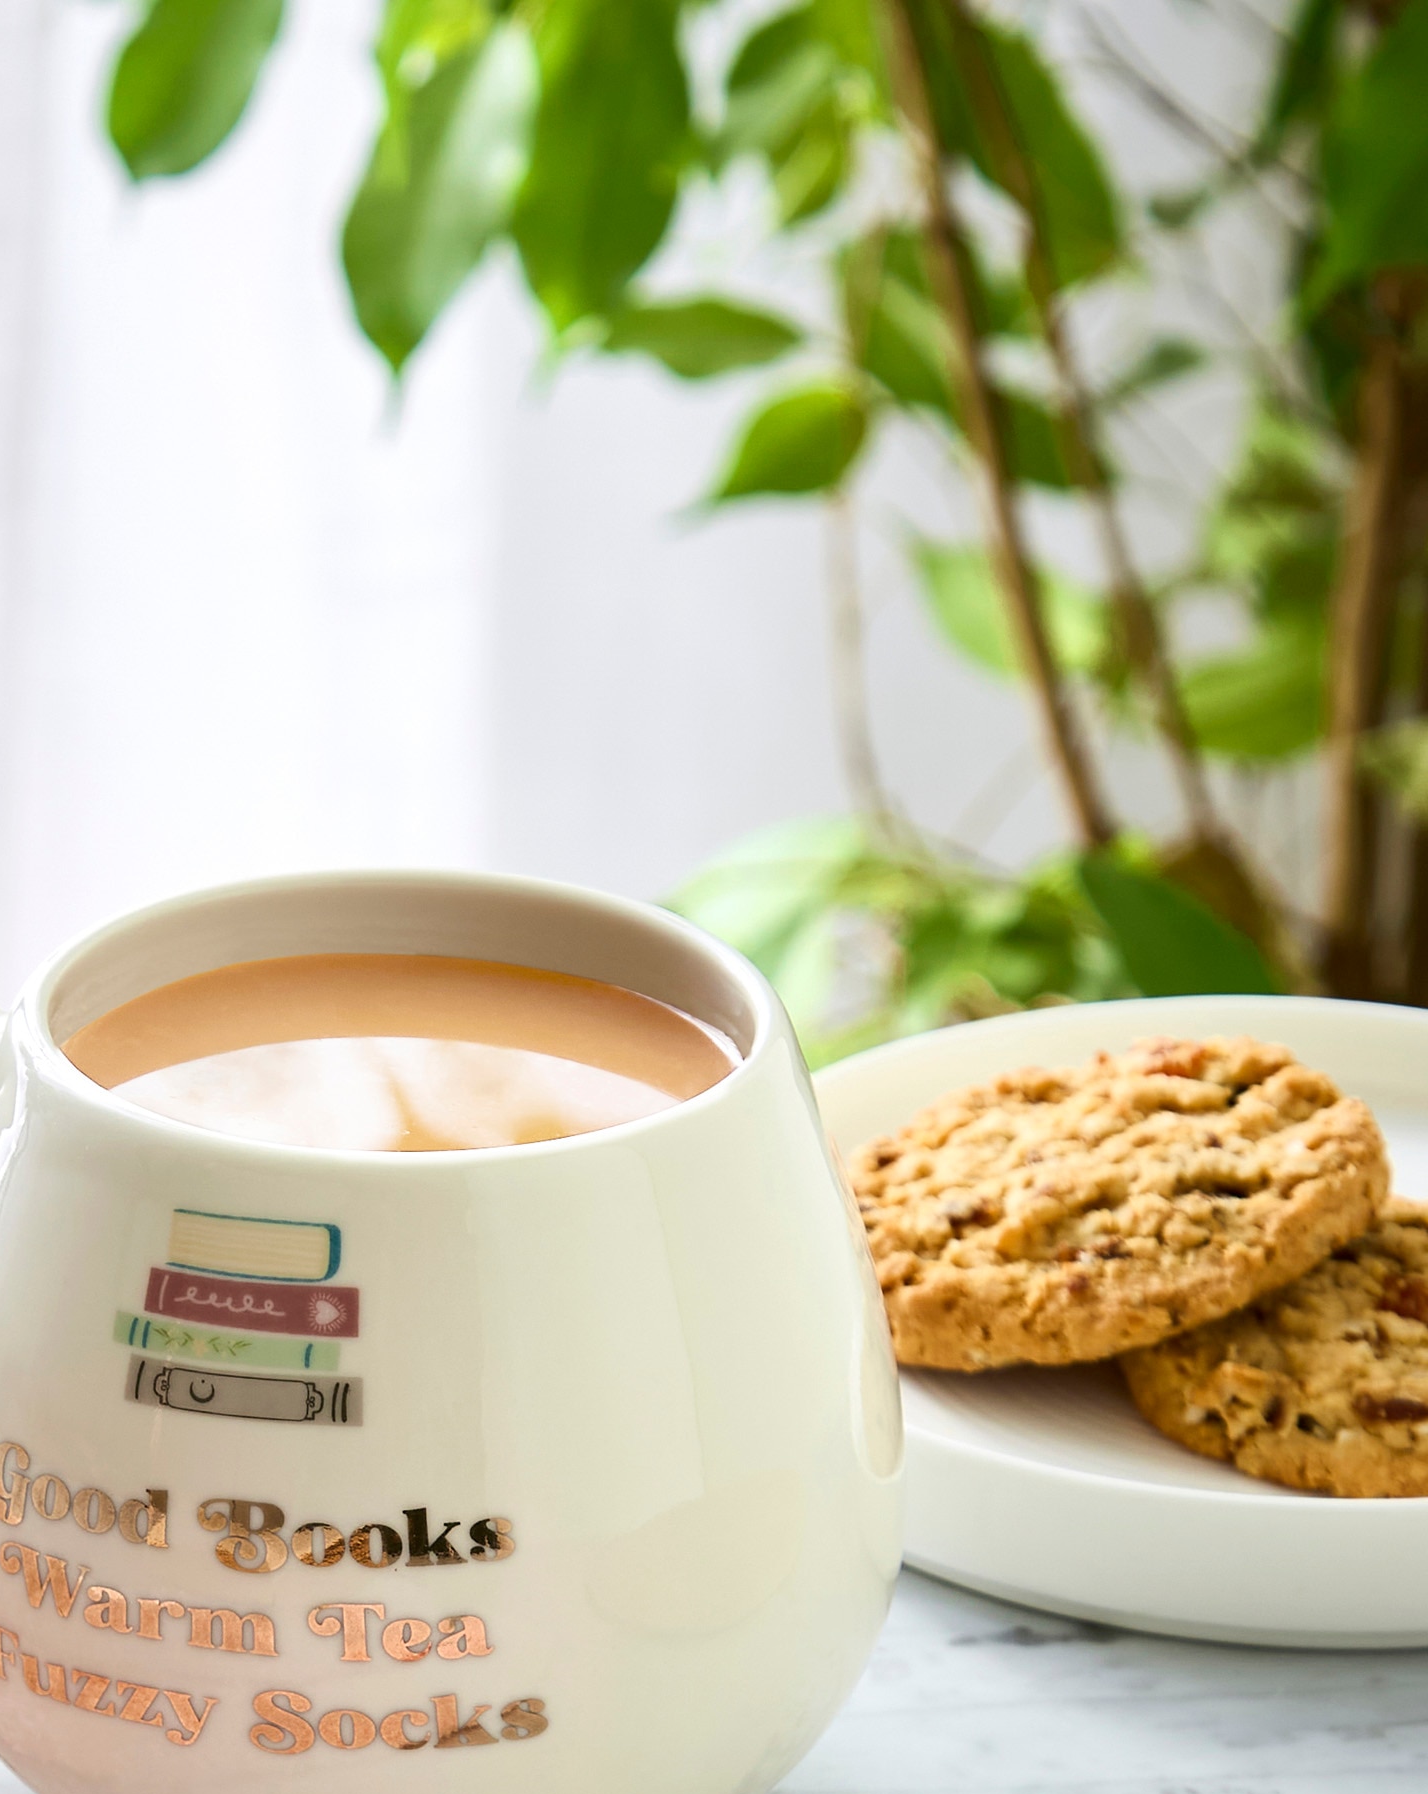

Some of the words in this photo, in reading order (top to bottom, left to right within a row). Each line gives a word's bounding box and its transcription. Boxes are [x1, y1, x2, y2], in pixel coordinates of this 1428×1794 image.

[197, 1498, 517, 1574] Books
[0, 1541, 279, 1657] Warm
[307, 1601, 494, 1663] Tea
[249, 1689, 549, 1755] Socks
